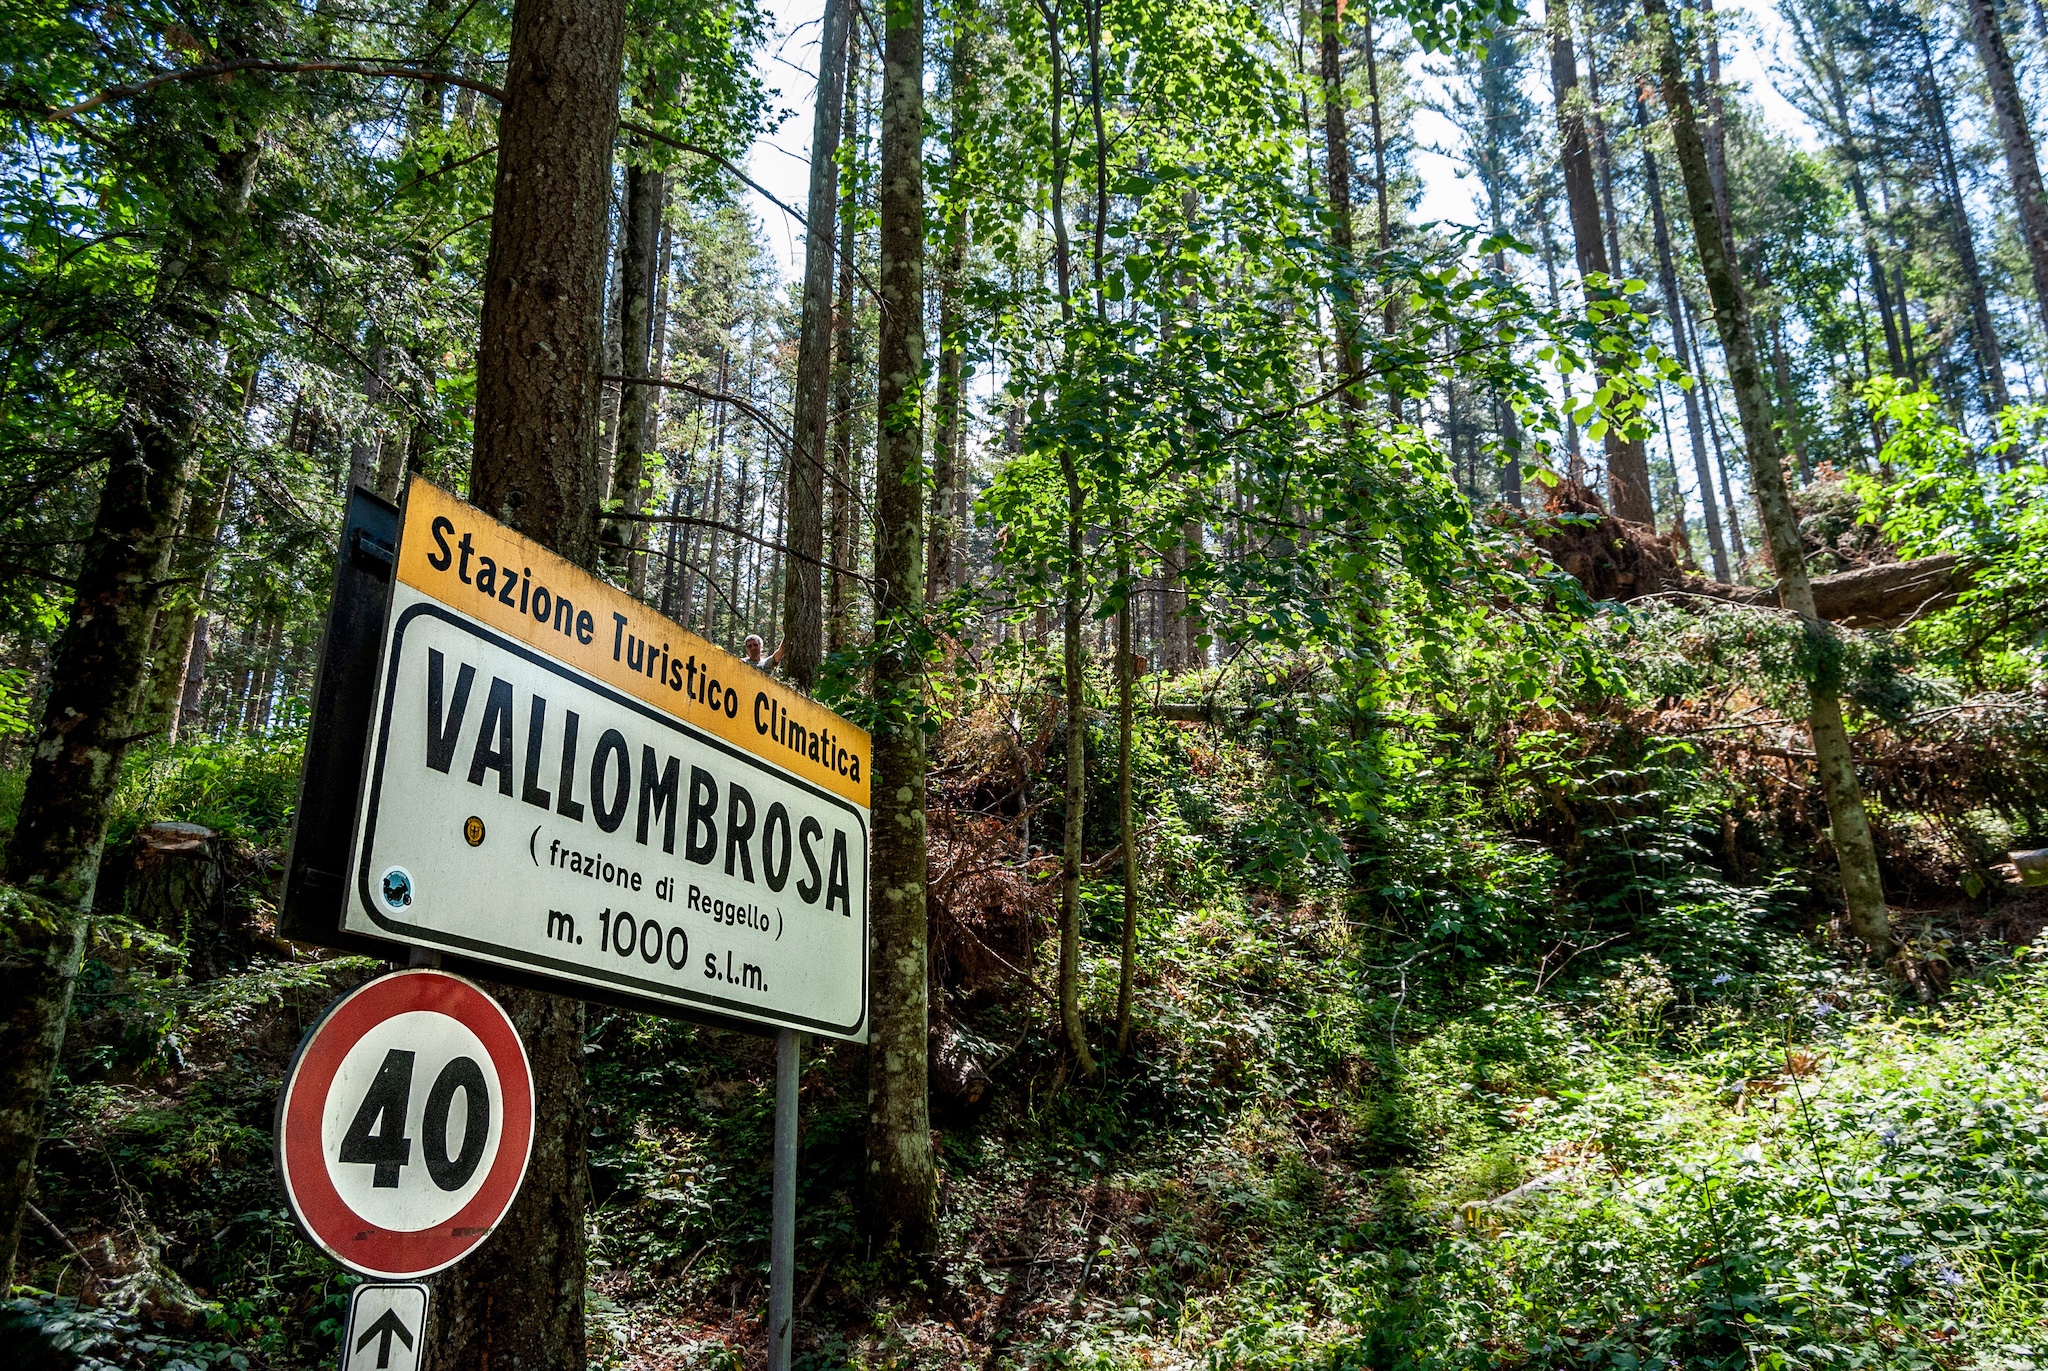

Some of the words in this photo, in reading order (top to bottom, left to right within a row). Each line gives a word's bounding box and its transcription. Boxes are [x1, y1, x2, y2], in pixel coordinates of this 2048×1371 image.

[426, 515, 594, 646] Stazione
[612, 611, 739, 719] Turistico
[753, 691, 861, 785] Climatica
[426, 647, 851, 918] VALLOMBROSA
[547, 909, 583, 946] m.
[599, 907, 689, 971] 1000
[704, 950, 768, 993] s.l.m.
[656, 876, 674, 903] di
[339, 1048, 490, 1192] 40
